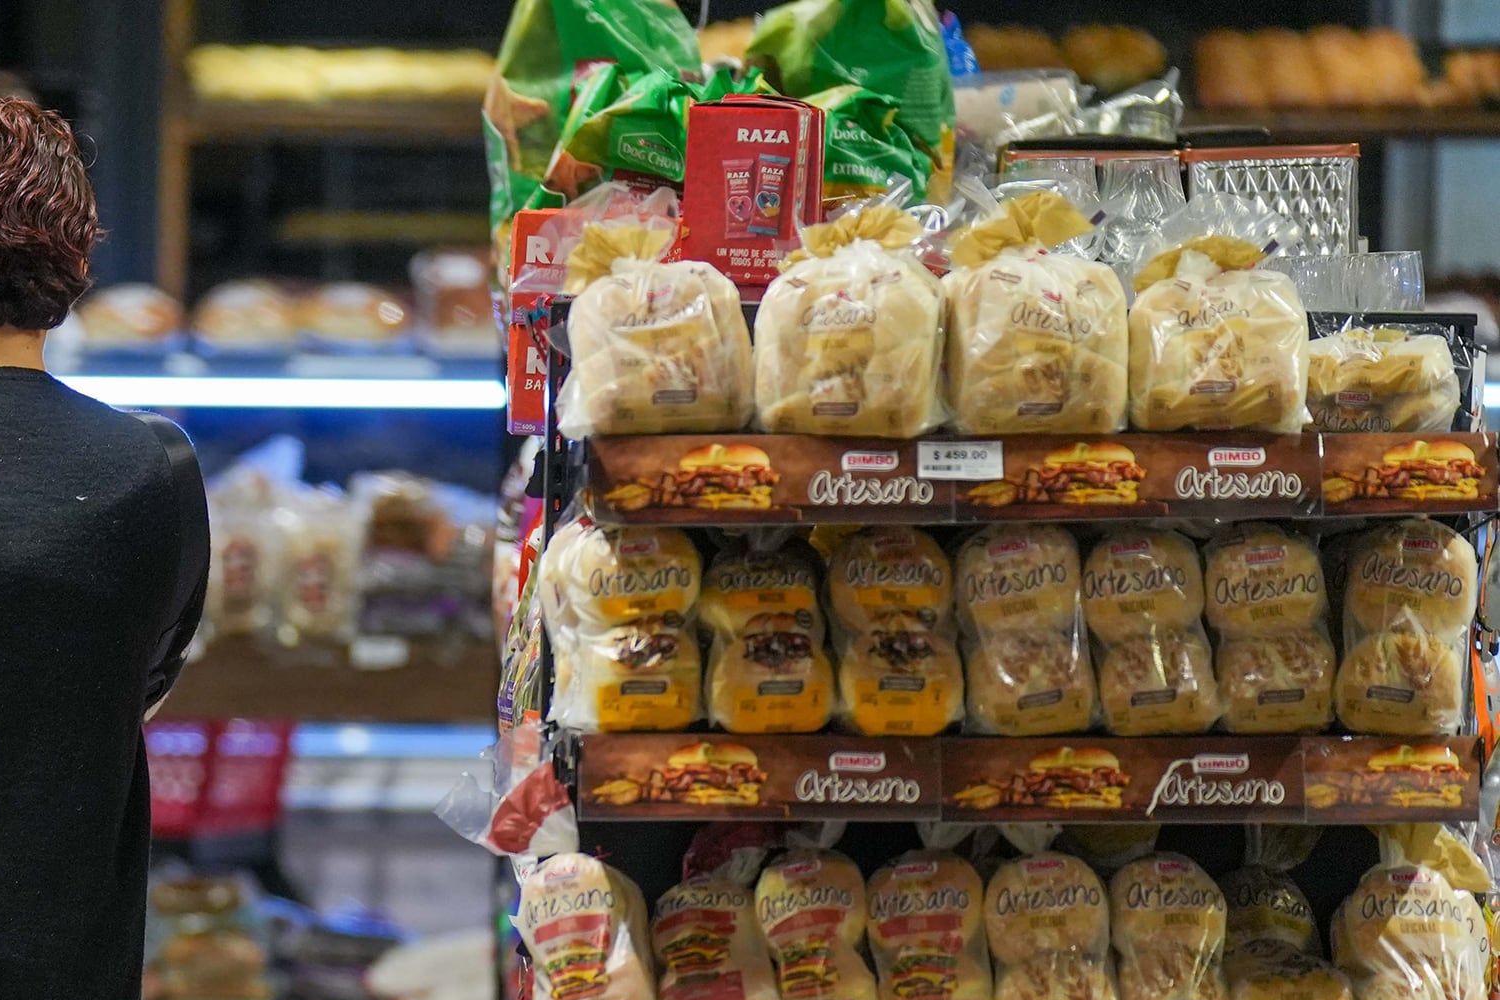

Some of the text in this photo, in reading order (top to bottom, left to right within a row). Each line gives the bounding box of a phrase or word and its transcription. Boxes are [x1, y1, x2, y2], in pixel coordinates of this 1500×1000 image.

[737, 128, 790, 144] RAZA
[762, 167, 784, 176] RAZA
[522, 423, 536, 432] 600g
[847, 453, 895, 466] BIMBO
[933, 450, 940, 460] $
[1214, 451, 1261, 464] BIMBO
[1245, 548, 1287, 564] BIMBO
[834, 755, 882, 768] BIMBO
